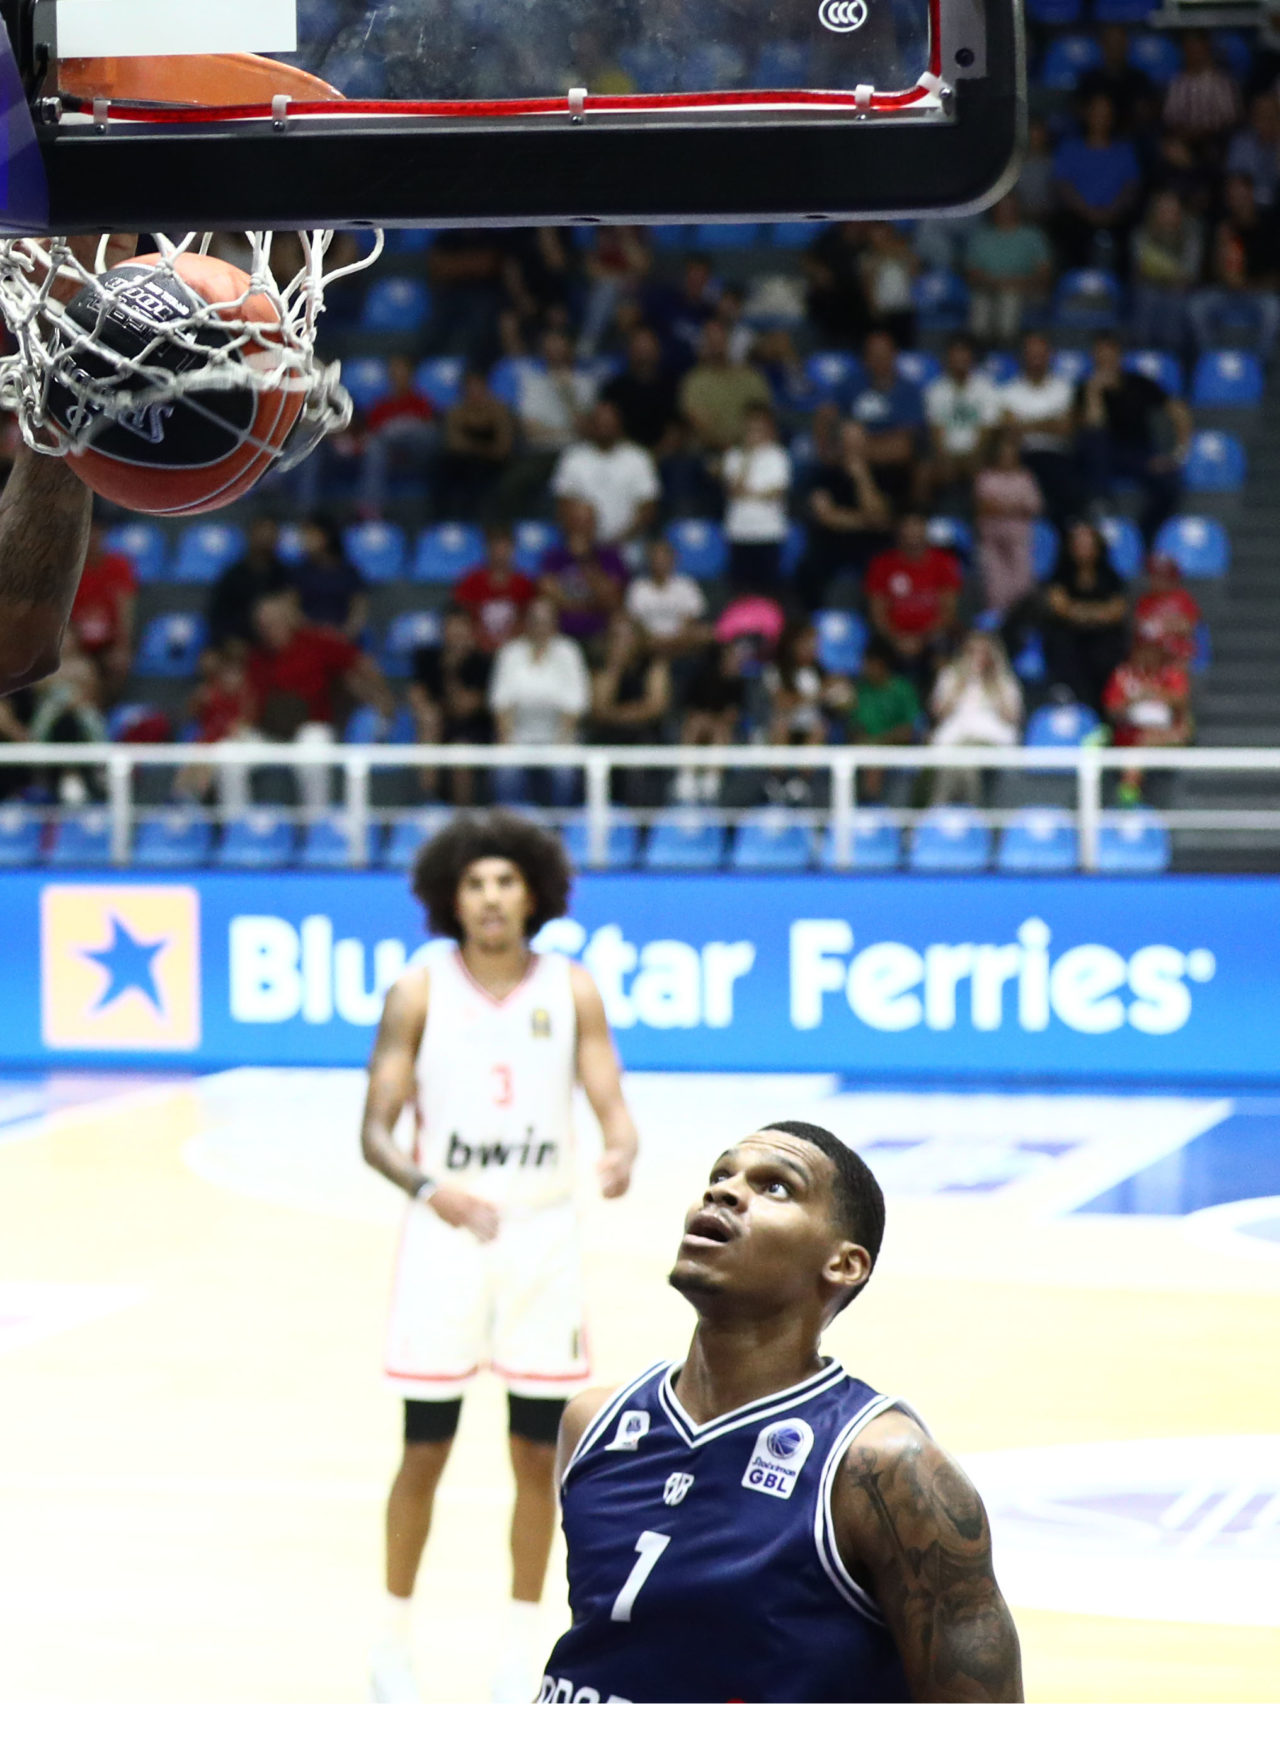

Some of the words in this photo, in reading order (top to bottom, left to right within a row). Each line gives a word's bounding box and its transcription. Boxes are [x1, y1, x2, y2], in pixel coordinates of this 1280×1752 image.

[229, 914, 408, 1026] Blu
[789, 916, 1193, 1034] Ferries
[749, 1469, 787, 1494] GBL
[611, 1531, 671, 1622] 1
